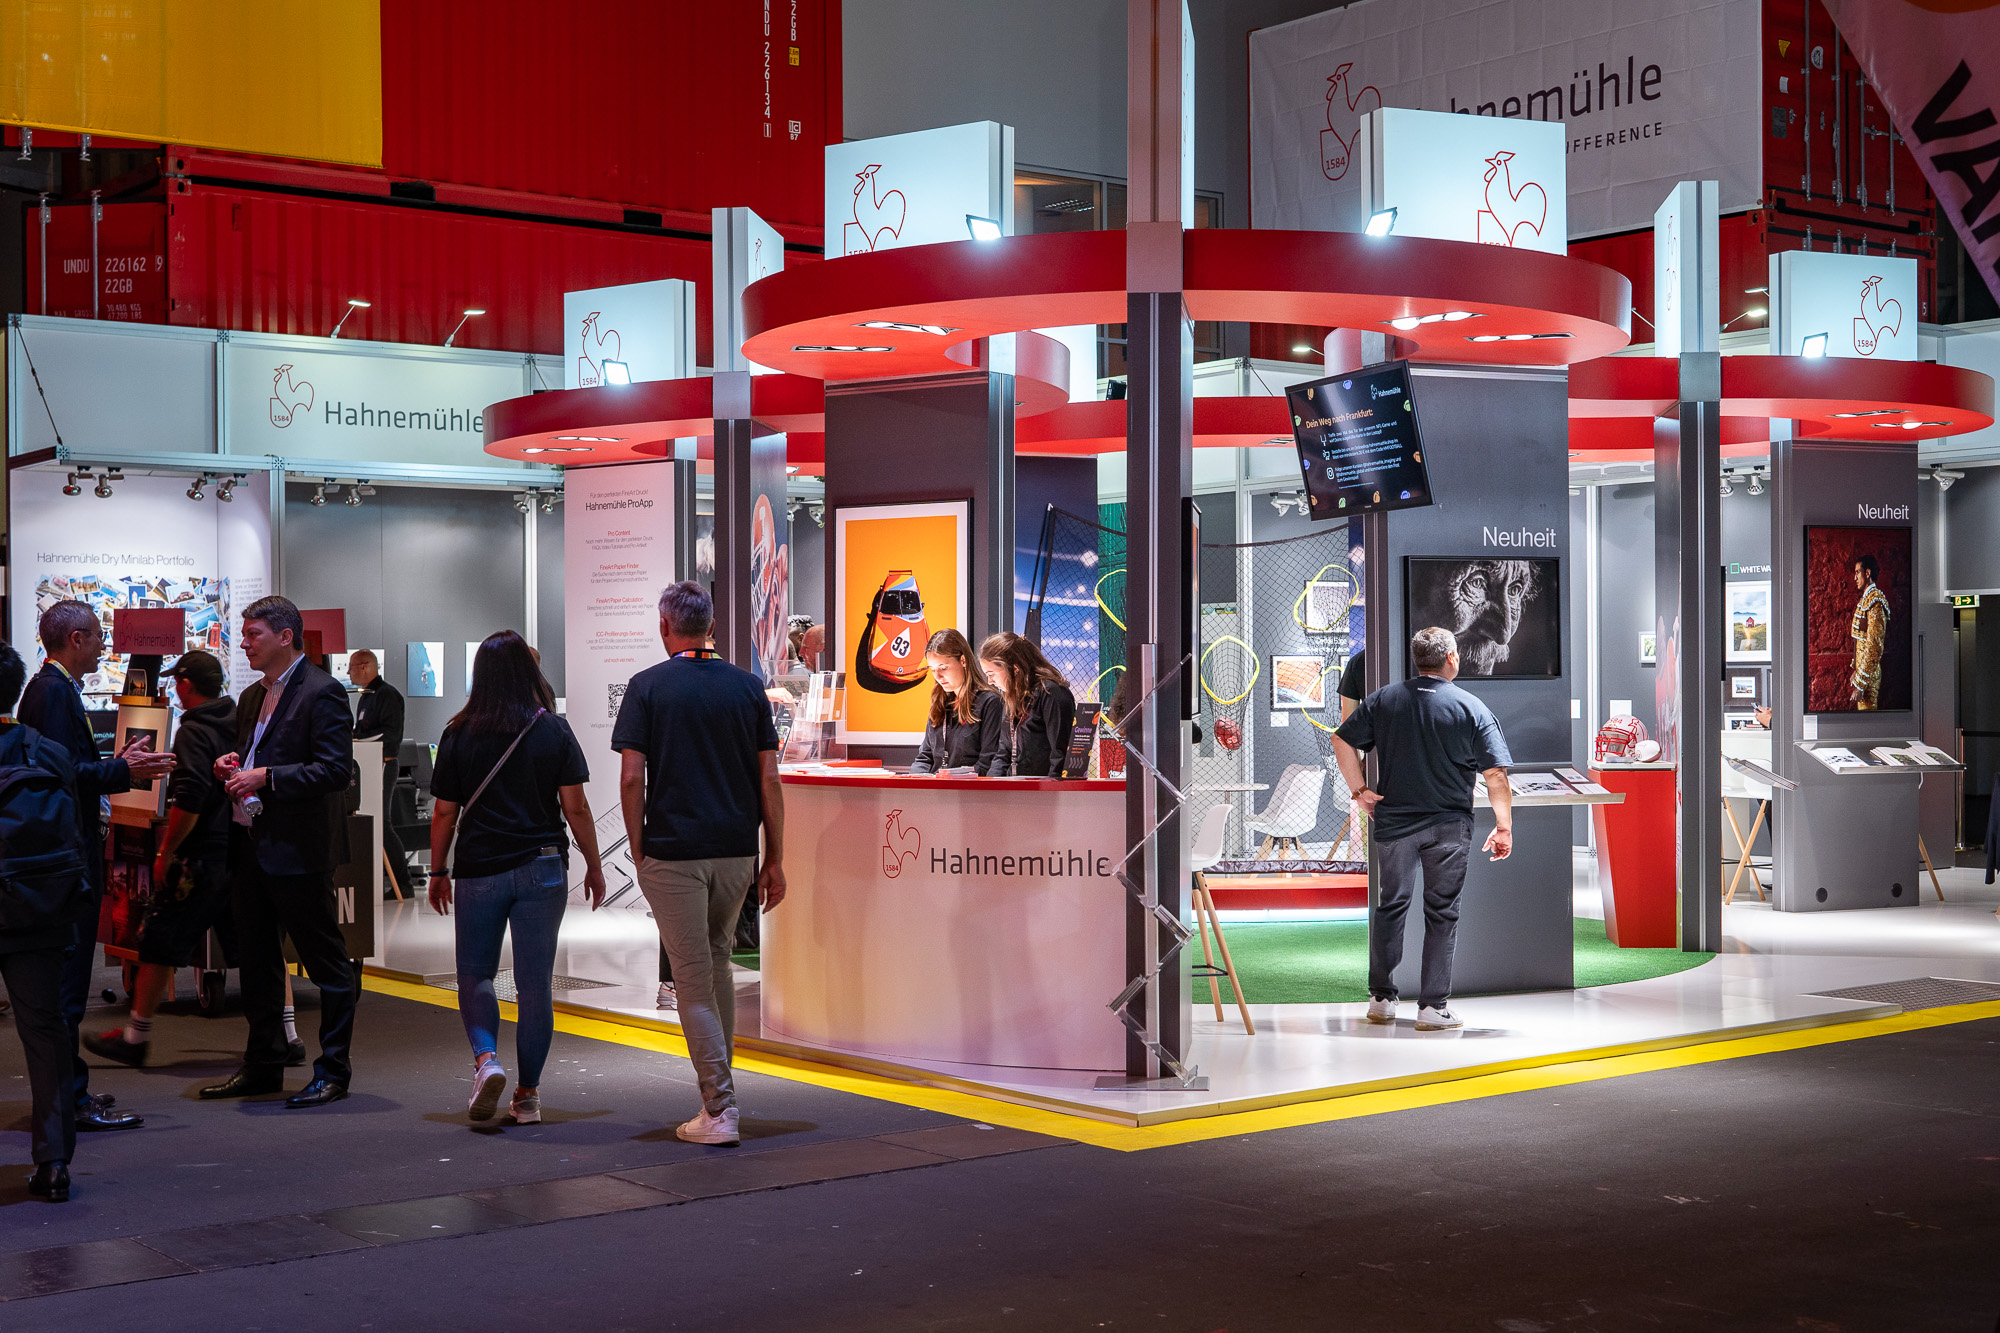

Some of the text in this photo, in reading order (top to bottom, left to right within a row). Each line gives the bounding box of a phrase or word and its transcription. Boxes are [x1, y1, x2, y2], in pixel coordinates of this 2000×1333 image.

[1416, 55, 1662, 121] nemühle
[1566, 122, 1662, 154] IFFERENCE
[1325, 156, 1346, 170] 1584
[63, 255, 163, 274] UNDU 226162 9
[105, 278, 133, 293] 22GB
[1857, 340, 1874, 348] 1584
[582, 377, 597, 386] 1584
[325, 401, 484, 433] Hahnemühle
[1305, 408, 1374, 429] Dein Weg nach Frankfurt:
[585, 499, 653, 511] Hahnemühle ProApp
[1858, 503, 1910, 520] Neuheit
[1483, 526, 1557, 548] Neuheit
[37, 552, 195, 567] Hahnemühle Dry Minilab Portfolio
[1740, 565, 1771, 573] WHITEWA
[133, 631, 176, 648] Hahnemühle
[892, 636, 910, 656] 93
[886, 864, 899, 872] 1584
[930, 847, 1111, 878] Hahnemühle
[334, 887, 355, 925] N
